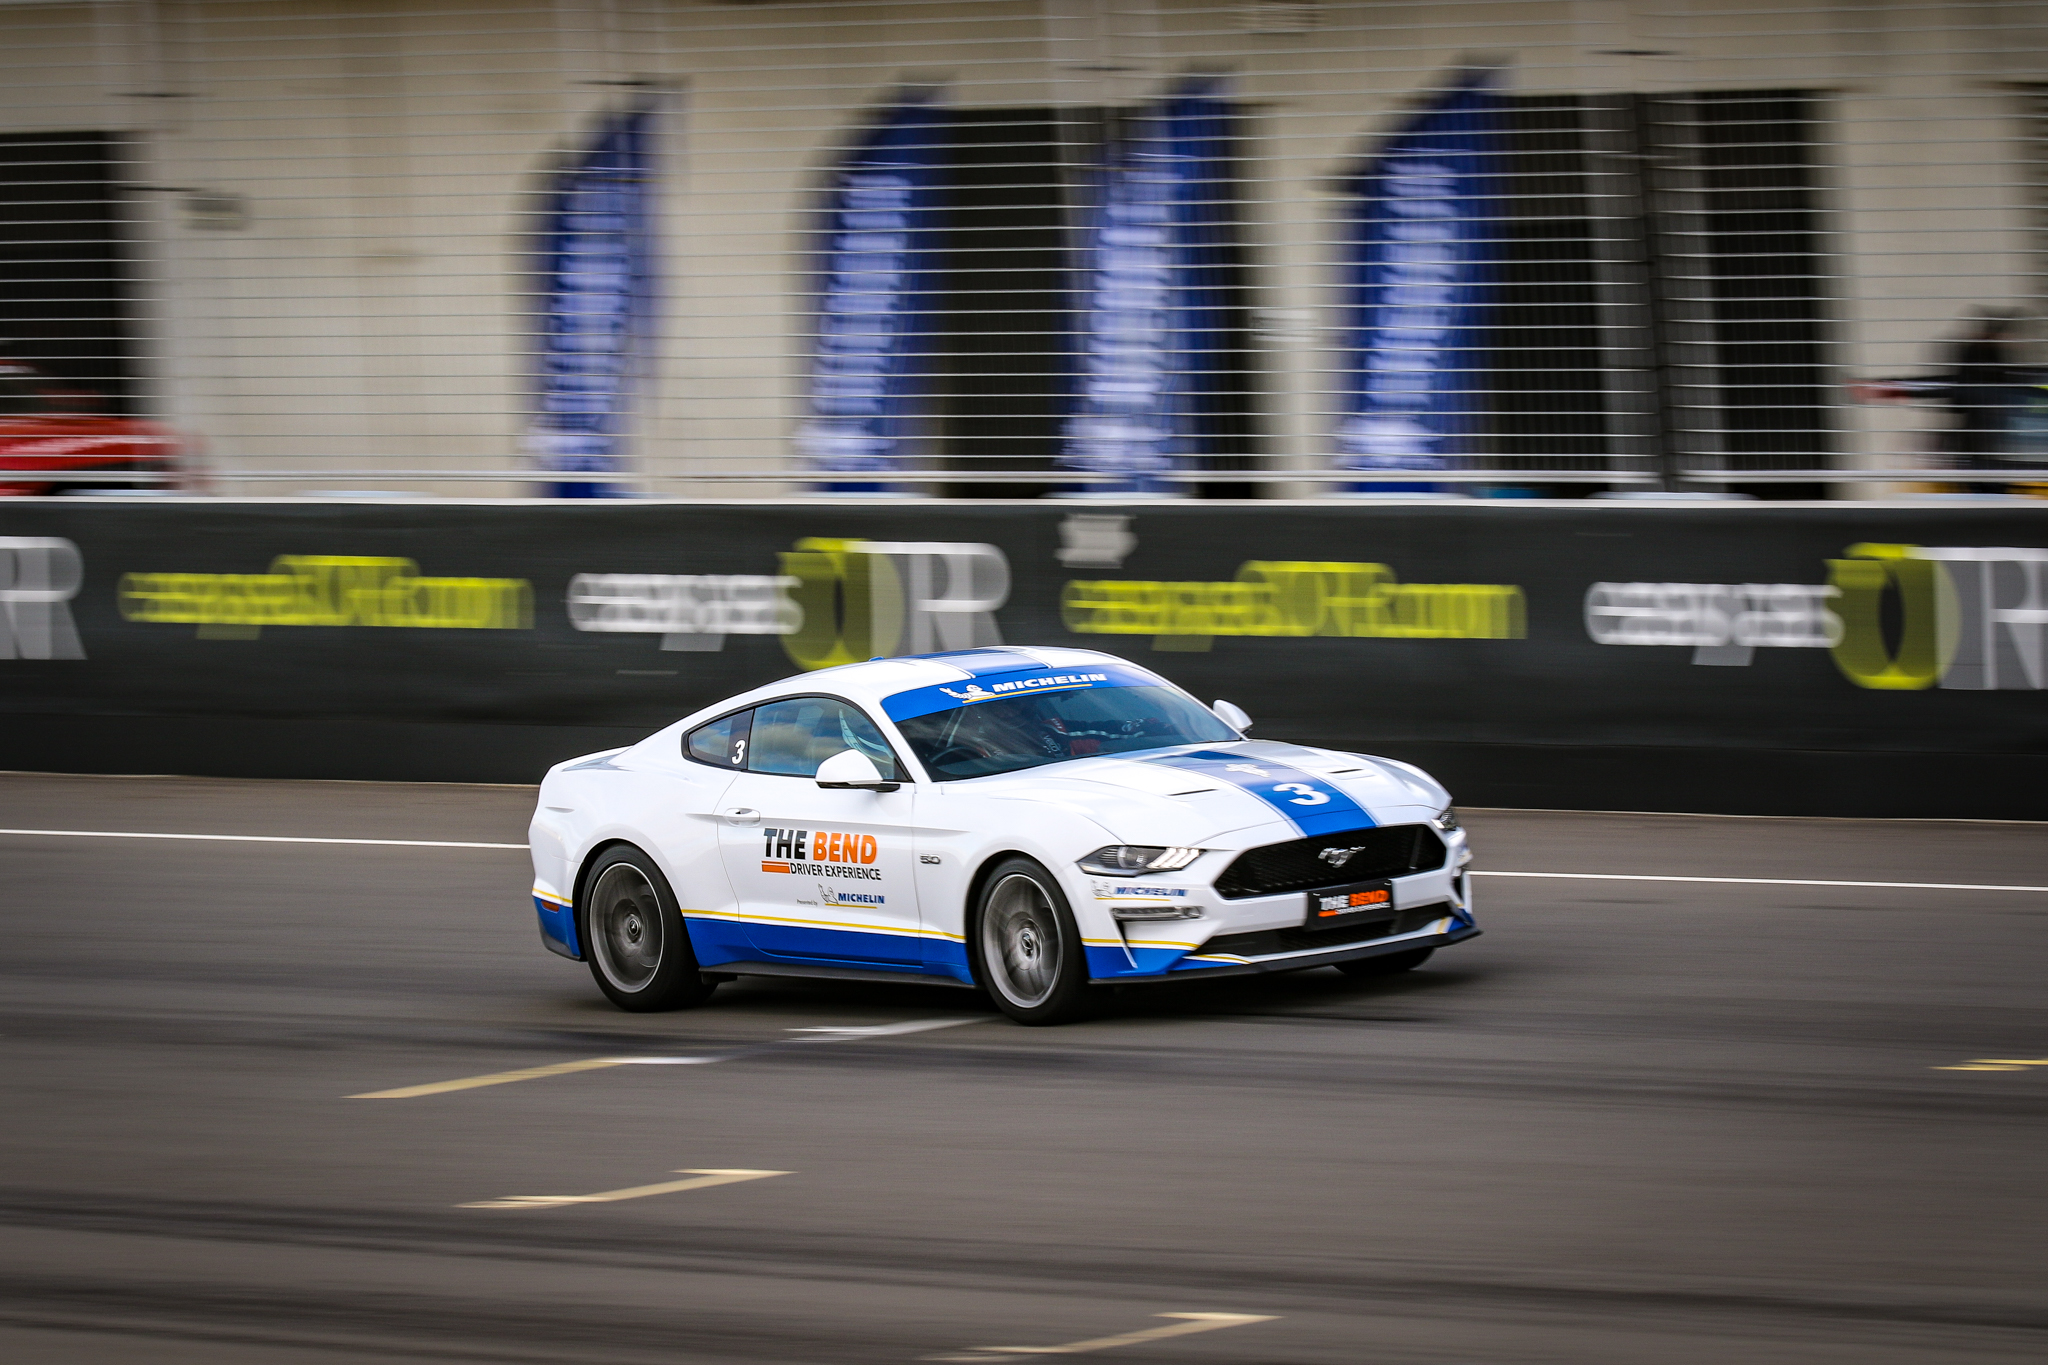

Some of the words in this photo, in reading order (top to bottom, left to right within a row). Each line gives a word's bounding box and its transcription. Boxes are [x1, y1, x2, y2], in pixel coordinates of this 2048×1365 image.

[992, 673, 1108, 692] MICHELIN
[731, 739, 746, 765] 3
[1272, 783, 1331, 806] 3
[763, 827, 808, 860] THE
[813, 831, 878, 864] BEND
[790, 862, 824, 877] DRIVER
[825, 864, 882, 881] EXPERIENCE
[838, 893, 885, 904] MICHELIN
[1114, 887, 1188, 897] MICHELIN
[1319, 895, 1350, 911] THE
[1349, 889, 1389, 907] BEND
